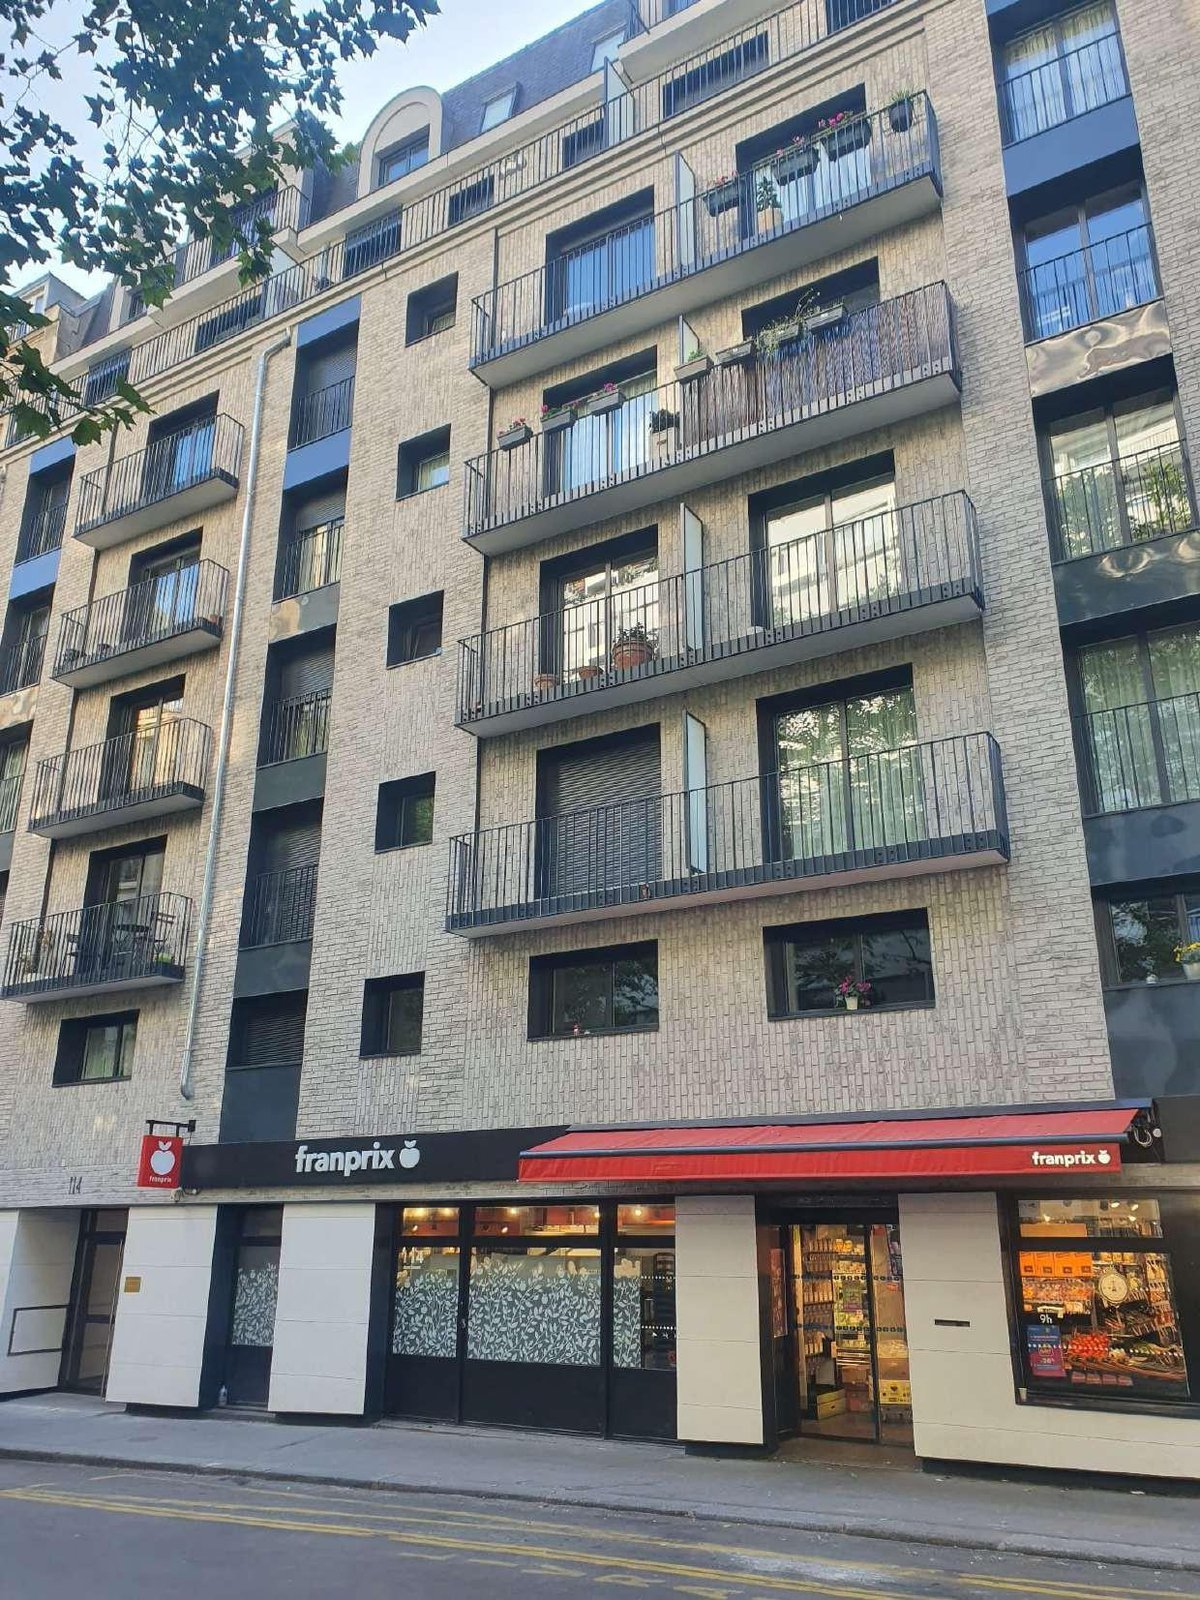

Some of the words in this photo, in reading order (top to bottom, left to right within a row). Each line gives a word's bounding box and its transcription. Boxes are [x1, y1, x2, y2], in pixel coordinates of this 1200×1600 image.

[295, 1141, 395, 1177] franprix
[1032, 1150, 1096, 1168] franprix
[69, 1176, 82, 1195] 114
[399, 1552, 777, 1600] LIVRA
